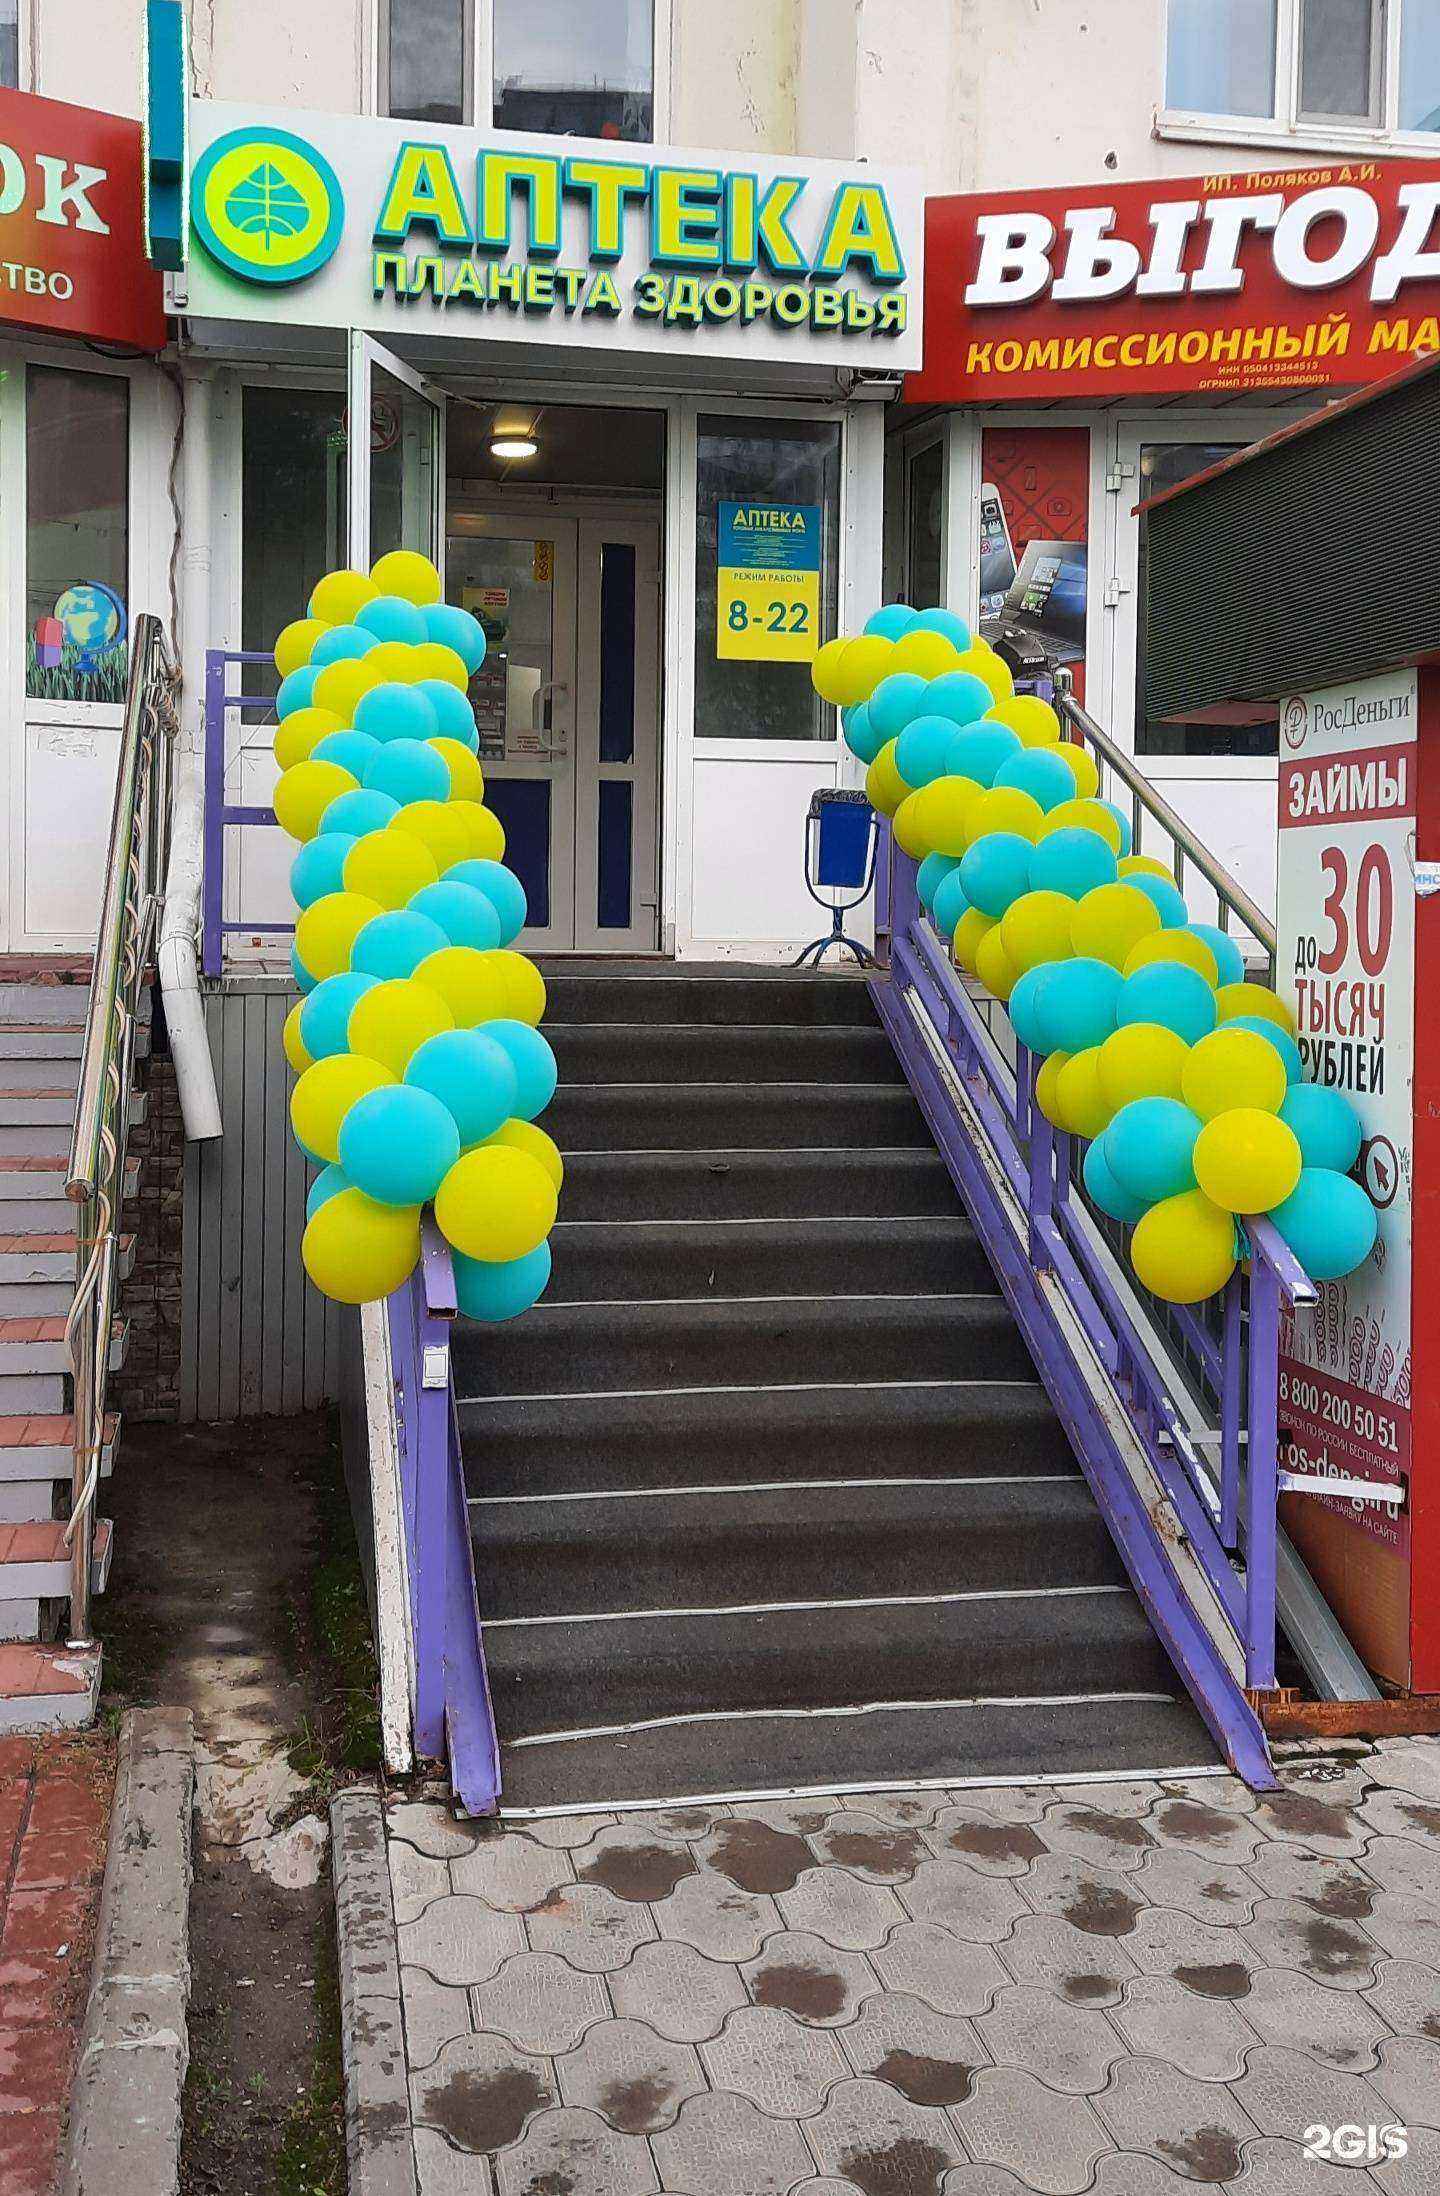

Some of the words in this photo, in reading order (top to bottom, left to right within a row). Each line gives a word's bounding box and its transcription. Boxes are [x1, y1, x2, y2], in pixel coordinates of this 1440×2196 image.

[1203, 174, 1238, 192] ИП.
[1246, 169, 1332, 189] Поляков
[373, 141, 906, 281] АПТЕКА
[0, 262, 74, 300] ТВО
[374, 253, 622, 312] ПЛАНЕТА
[635, 271, 907, 332] ЗДОРОВЬЯ
[966, 312, 1351, 374] КОМИССИОННЫЙ
[733, 508, 806, 528] АПТЕКА
[733, 572, 767, 582] РЕЖИМ
[768, 574, 804, 583] РАБОТЫ
[728, 600, 809, 633] 8-22
[1313, 695, 1411, 734] РосДеньги
[1289, 757, 1407, 818] ЗАЙМЫ
[1318, 843, 1393, 977] 30
[1295, 978, 1385, 1041] ТЫСЯЧ
[1298, 1036, 1385, 1095] РУБЛЕЙ
[1279, 1372, 1288, 1401] 8
[1291, 1377, 1319, 1414] 800
[1322, 1390, 1351, 1430] 200
[1354, 1404, 1375, 1441] 50
[1378, 1415, 1399, 1453] 51
